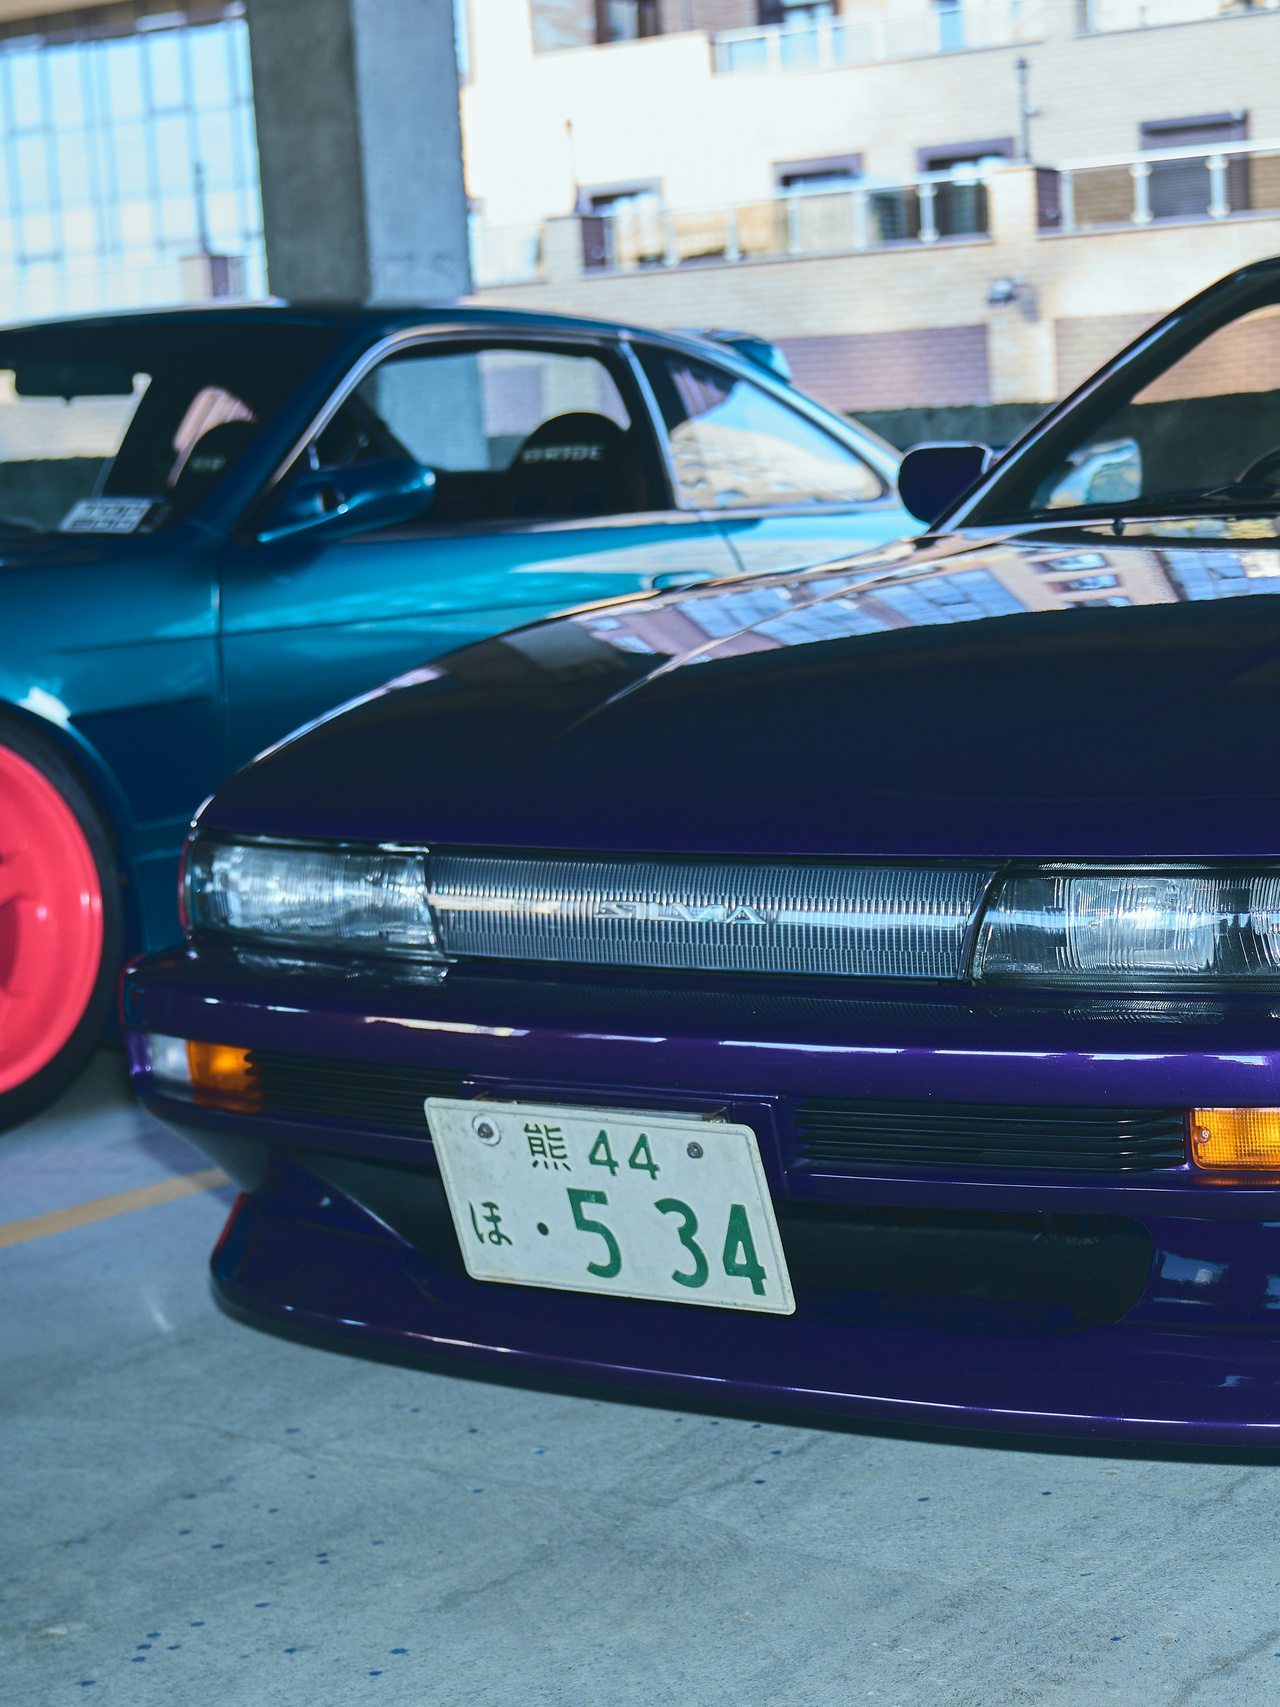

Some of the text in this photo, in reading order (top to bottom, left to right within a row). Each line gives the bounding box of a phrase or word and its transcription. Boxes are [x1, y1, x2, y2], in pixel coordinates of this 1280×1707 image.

[595, 900, 767, 925] SILVIA
[523, 1122, 661, 1181] 熊 44
[469, 1200, 513, 1246] ほ
